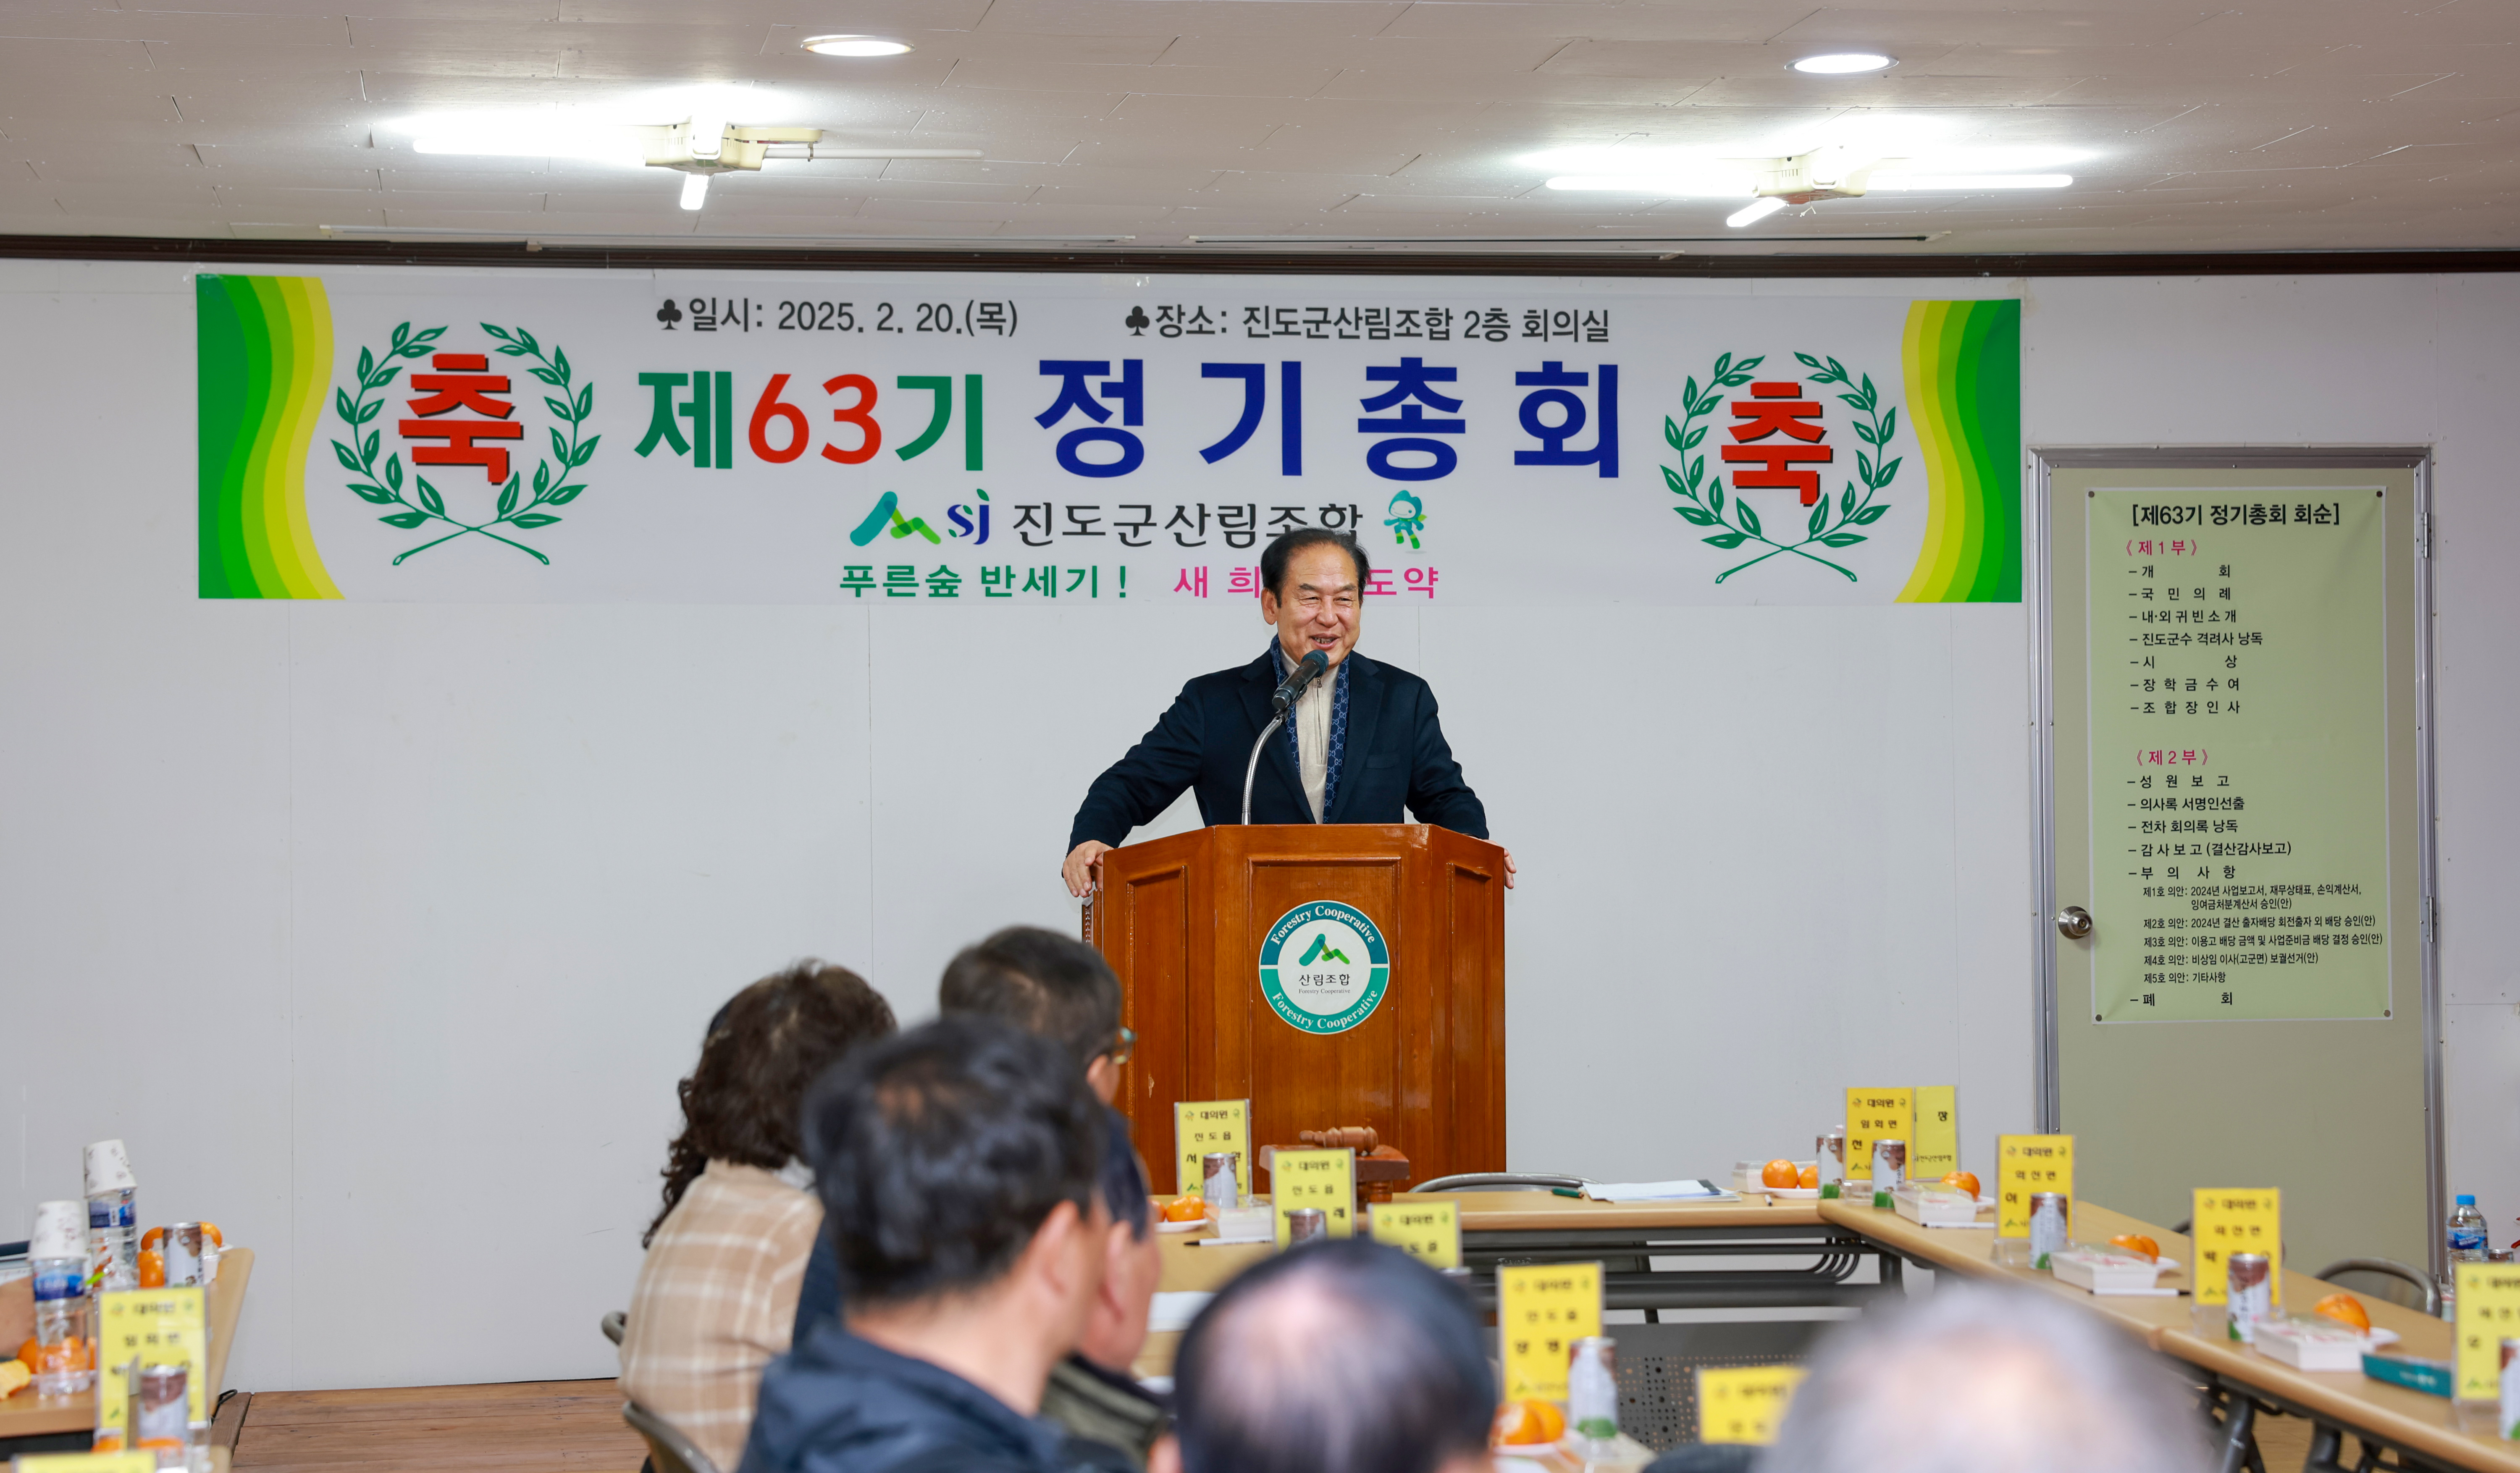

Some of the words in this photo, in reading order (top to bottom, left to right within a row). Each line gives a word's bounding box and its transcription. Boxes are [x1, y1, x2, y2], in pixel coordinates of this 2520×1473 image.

[690, 298, 762, 332] 일시:
[779, 301, 863, 333] 2025.
[877, 303, 903, 333] 2.
[917, 300, 1017, 337] 20.(목)
[1156, 304, 1226, 338] 장소:
[1243, 306, 1453, 341] 진도군산림조합
[1464, 308, 1510, 342] 2층
[1522, 309, 1608, 342] 회의실
[399, 354, 523, 484] 축
[634, 371, 983, 471] 제63기
[1721, 382, 1833, 507] 축
[2133, 504, 2202, 526] [제63기
[2210, 504, 2286, 525] 정기총회
[2294, 503, 2339, 525] 회순]
[840, 565, 962, 597] 푸른숲
[982, 565, 1097, 598] 반세기
[1174, 566, 1207, 598] 새
[2143, 633, 2192, 645] 진도군수
[2197, 632, 2234, 645] 격려사
[2239, 632, 2263, 645] 낭독
[2141, 798, 2177, 811] 의사록
[2182, 797, 2244, 810] 서명인선출
[2142, 820, 2166, 833] 전차
[2171, 820, 2208, 833] 회의록
[2213, 820, 2238, 833] 낭독
[2207, 841, 2291, 856] (결산감사보고)
[2143, 887, 2165, 897] 제1호
[2168, 886, 2187, 897] 의안:
[2191, 886, 2219, 896] 2024년
[2223, 885, 2266, 896] 사업보고서,
[2270, 885, 2314, 895] 재무상태표,
[2317, 884, 2361, 895] 손익계산서,
[2192, 899, 2257, 910] 잉여금처분계산서
[2260, 898, 2292, 909] 승인(안)
[1270, 910, 1311, 945] Forestry
[1315, 906, 1375, 943] Cooperative
[2144, 919, 2165, 929] 제2호
[2168, 918, 2187, 929] 의안:
[2192, 917, 2220, 928] 2024년
[2223, 917, 2239, 928] 결산
[2242, 917, 2275, 928] 출자배당
[2278, 916, 2311, 927] 회전출자
[2315, 916, 2322, 927] 외
[2326, 916, 2341, 927] 배당
[2344, 915, 2375, 926] 승인(안)
[2144, 937, 2165, 947] 제3호
[2168, 936, 2187, 947] 의안:
[2192, 936, 2216, 947] 이용고
[2220, 936, 2236, 946] 배당
[2239, 936, 2254, 946] 금액
[2258, 935, 2265, 946] 및
[2269, 935, 2310, 946] 사업준비금
[2313, 934, 2329, 945] 배당
[2333, 934, 2348, 945] 결정
[2352, 933, 2382, 945] 승인(안)
[2144, 955, 2165, 966] 제4호
[2168, 955, 2188, 965] 의안:
[2192, 954, 2216, 965] 비상임
[2220, 953, 2267, 965] 이사(고군면)
[2271, 952, 2318, 964] 보궐선거(안)
[1299, 974, 1350, 986] 산림조합
[2144, 973, 2166, 983] 제5호
[2169, 972, 2188, 983] 의안:
[2193, 972, 2226, 983] 기타사항
[1272, 992, 1314, 1029] Forestry
[1317, 990, 1378, 1028] Cooperative
